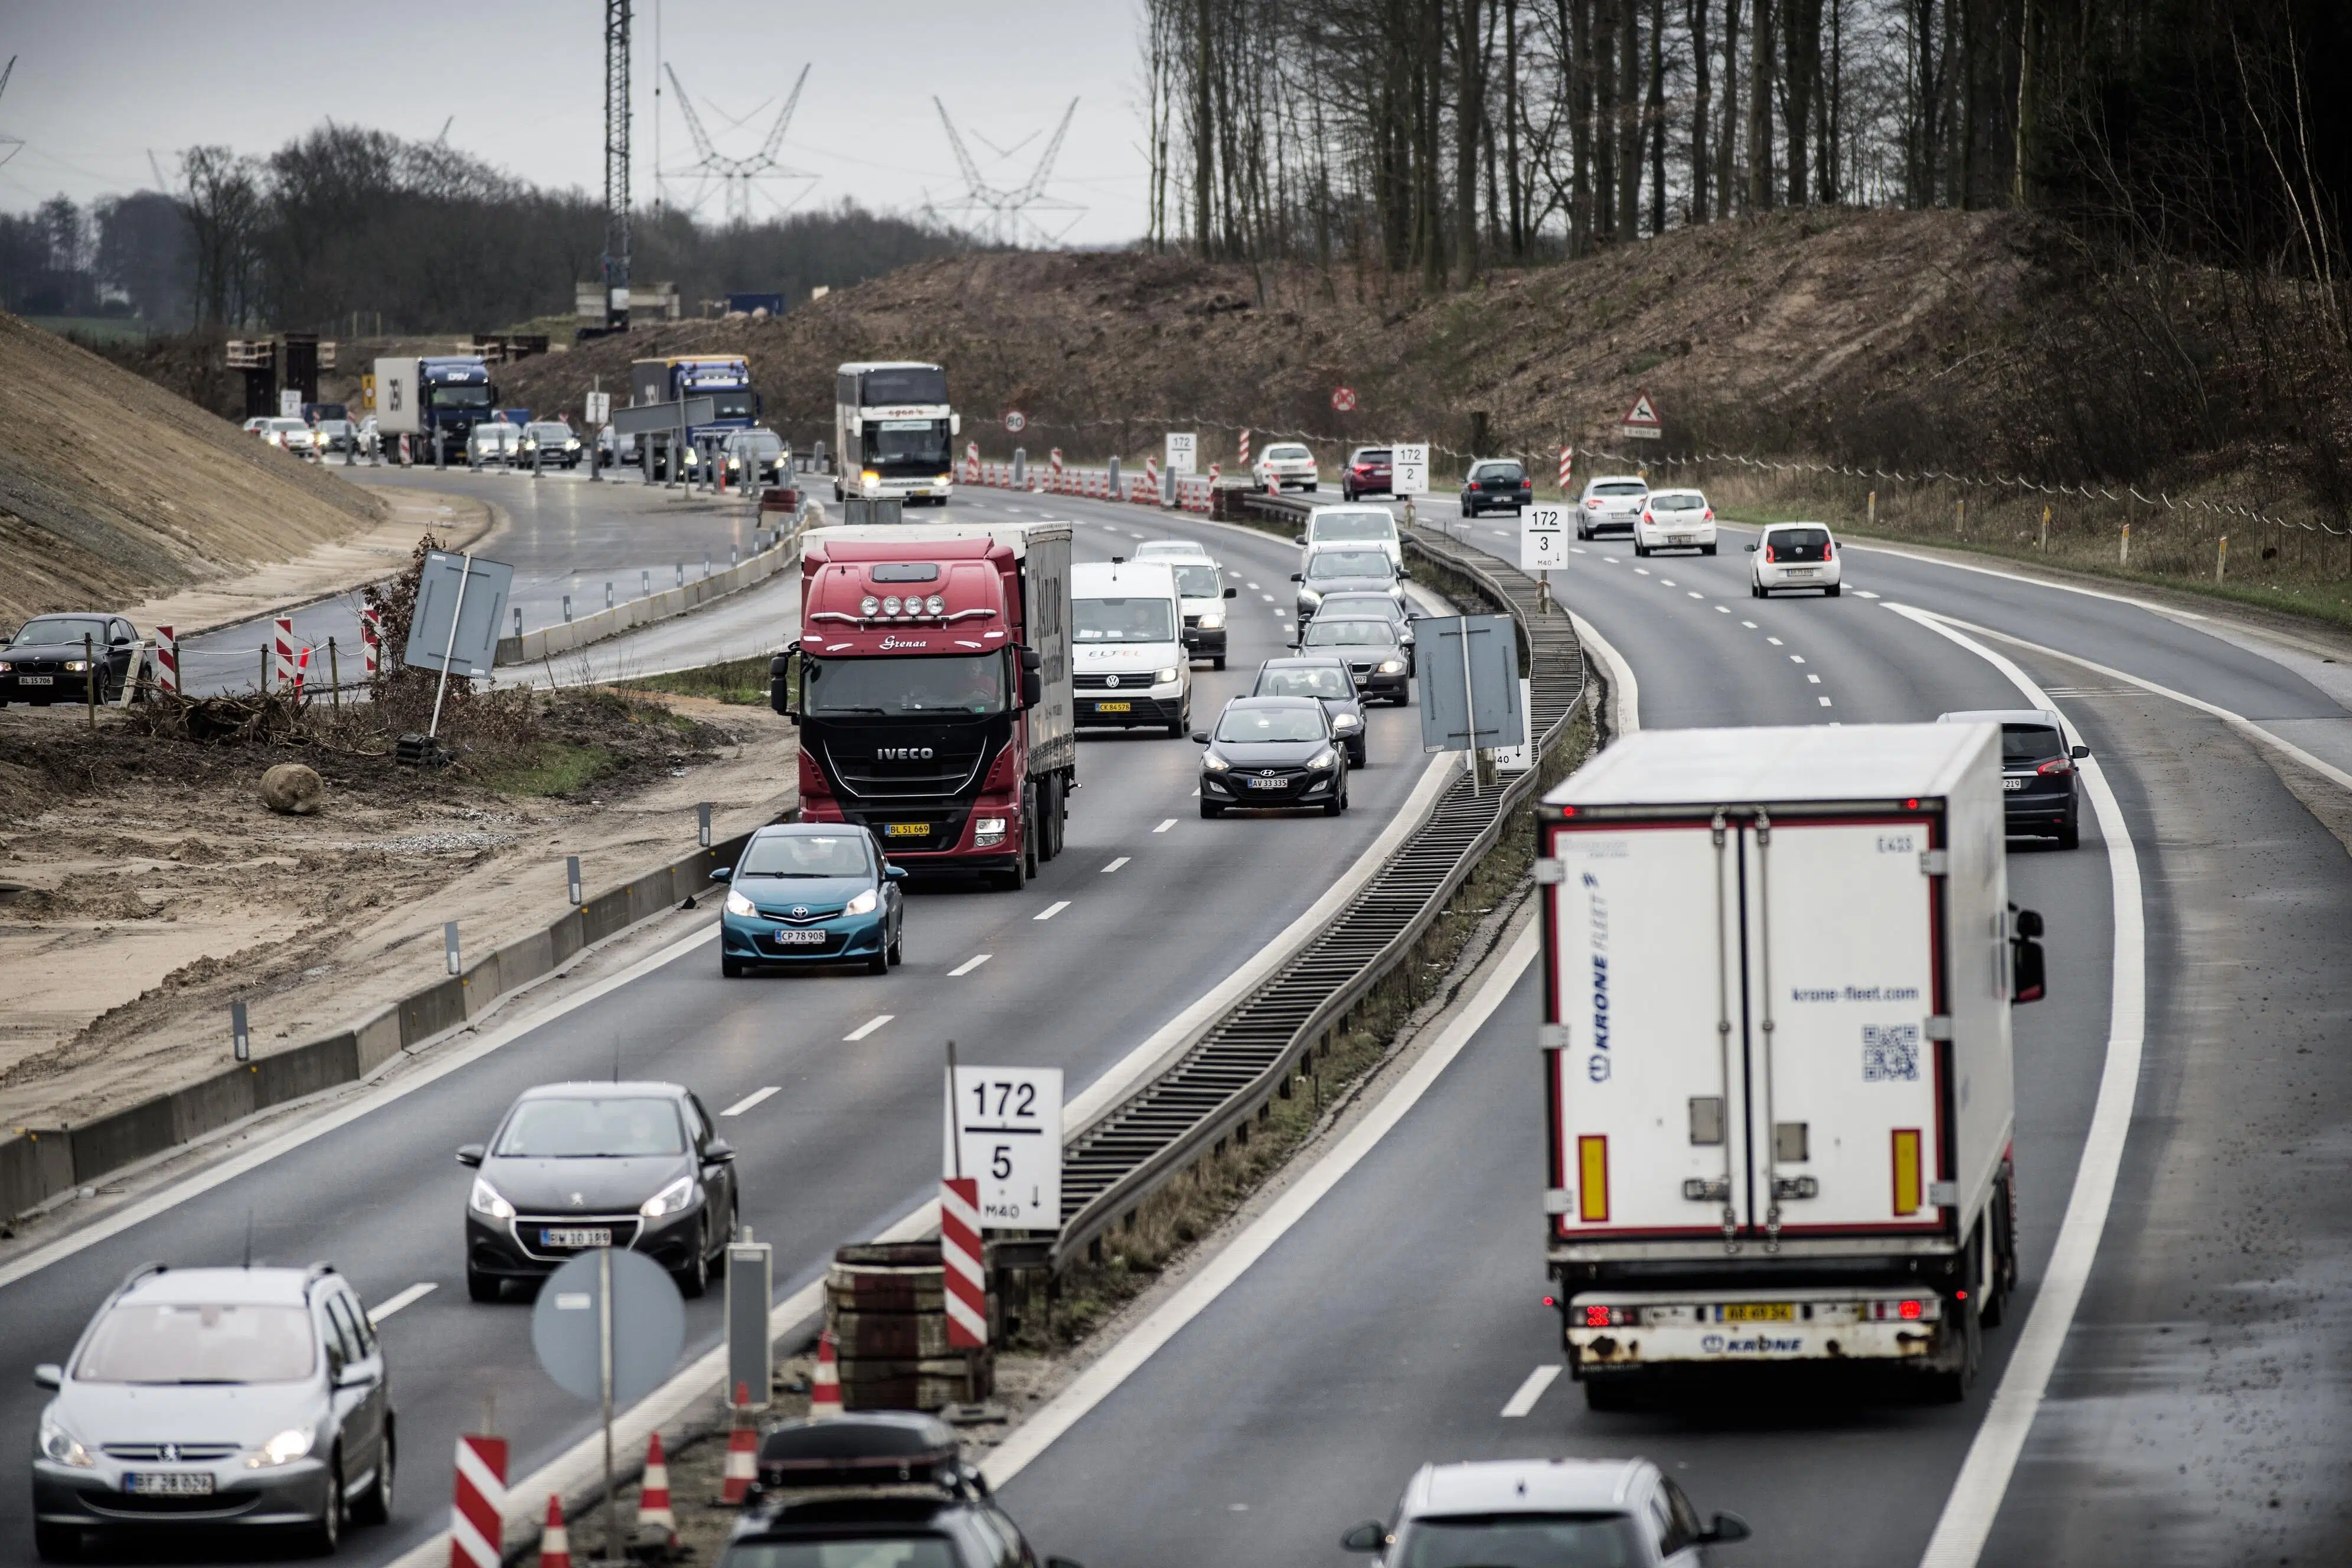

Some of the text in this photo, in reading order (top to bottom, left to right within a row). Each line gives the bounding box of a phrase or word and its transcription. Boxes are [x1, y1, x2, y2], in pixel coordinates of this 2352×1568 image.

[1007, 416, 1023, 426] 80
[1173, 437, 1190, 447] 172
[1179, 453, 1183, 462] 1
[1401, 449, 1420, 460] 172
[1407, 468, 1414, 479] 2
[1532, 511, 1558, 525] 172
[1540, 536, 1549, 550] 3
[879, 635, 927, 650] Grenaa
[877, 748, 933, 760] IVECO
[782, 932, 824, 940] CP 78 908
[1589, 892, 1610, 1051] KRONE FLEET
[1792, 985, 1919, 1002] krone-fleet.com
[973, 1083, 1037, 1116] 172
[992, 1146, 1011, 1180] 5
[985, 1204, 1020, 1219] M40
[570, 1233, 584, 1245] 10
[1727, 1337, 1804, 1353] KRONE
